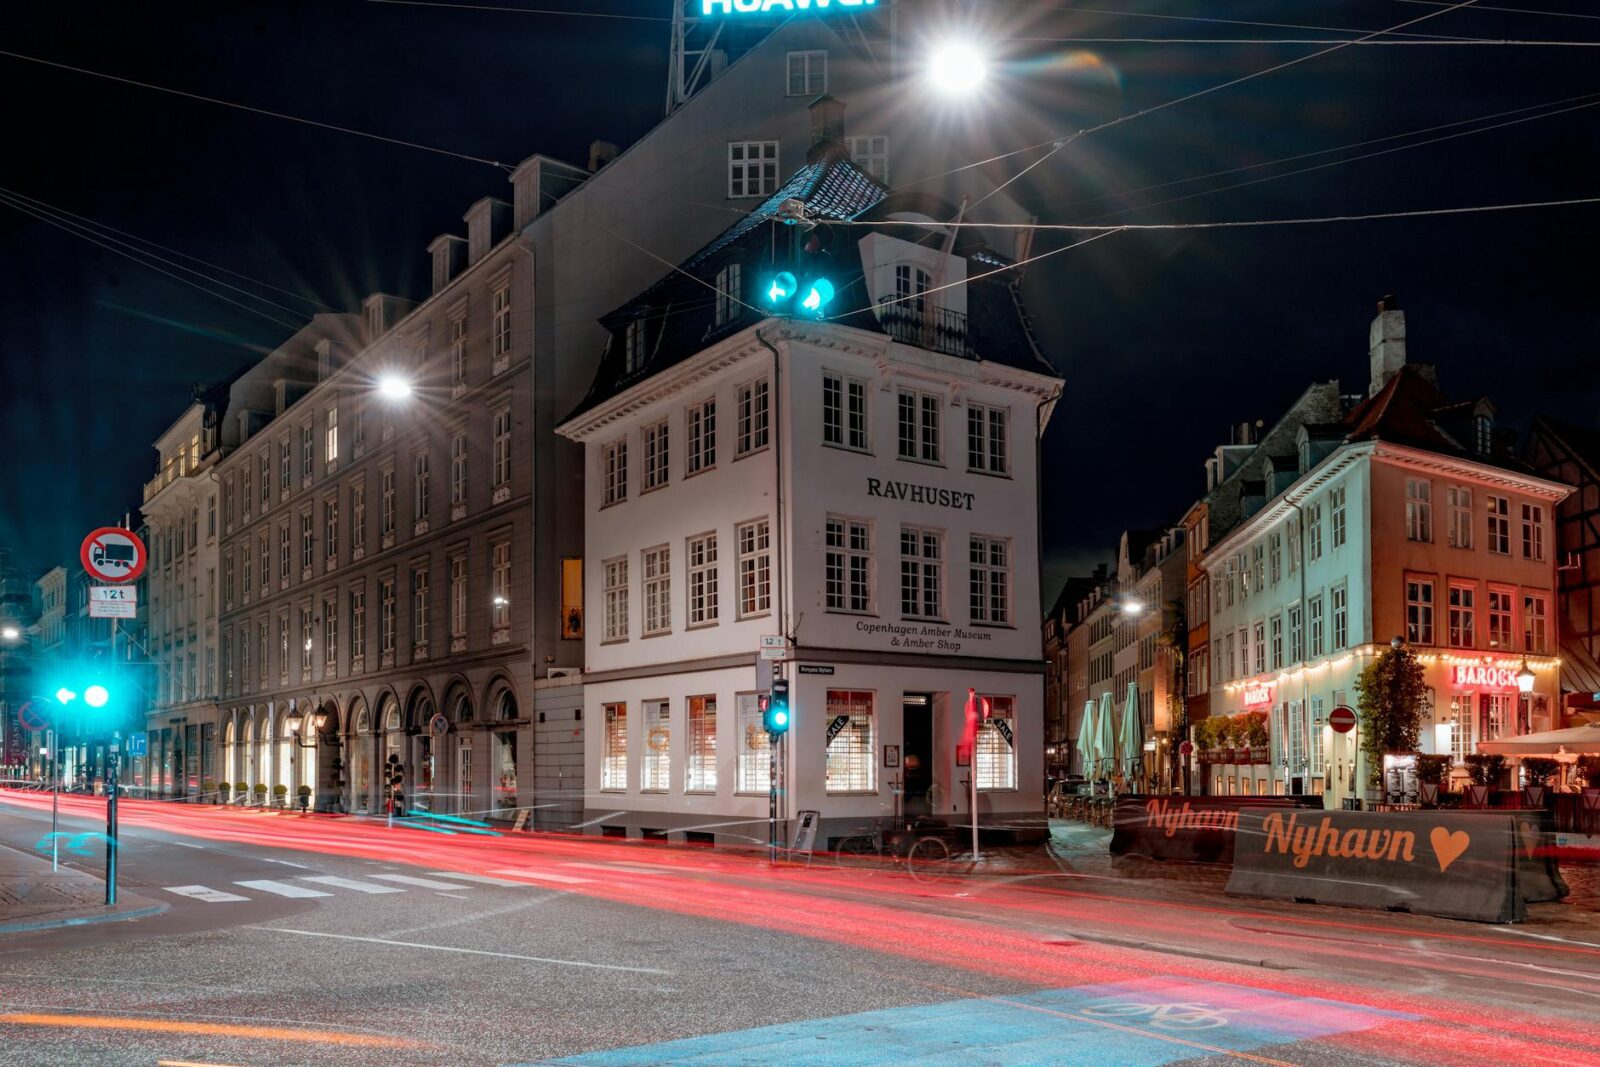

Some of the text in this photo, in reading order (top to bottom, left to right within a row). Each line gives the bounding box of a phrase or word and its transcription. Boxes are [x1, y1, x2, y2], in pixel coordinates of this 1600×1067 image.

[866, 477, 975, 511] RAVHUSET
[856, 621, 992, 641] Copenhagen Amber Museum
[890, 637, 961, 652] & Amber Shop
[1457, 666, 1518, 687] BAROCK
[827, 717, 844, 739] SALE
[996, 720, 1012, 741] SALE
[1145, 798, 1240, 838] Nyhavn
[1262, 812, 1416, 868] Nyhavn
